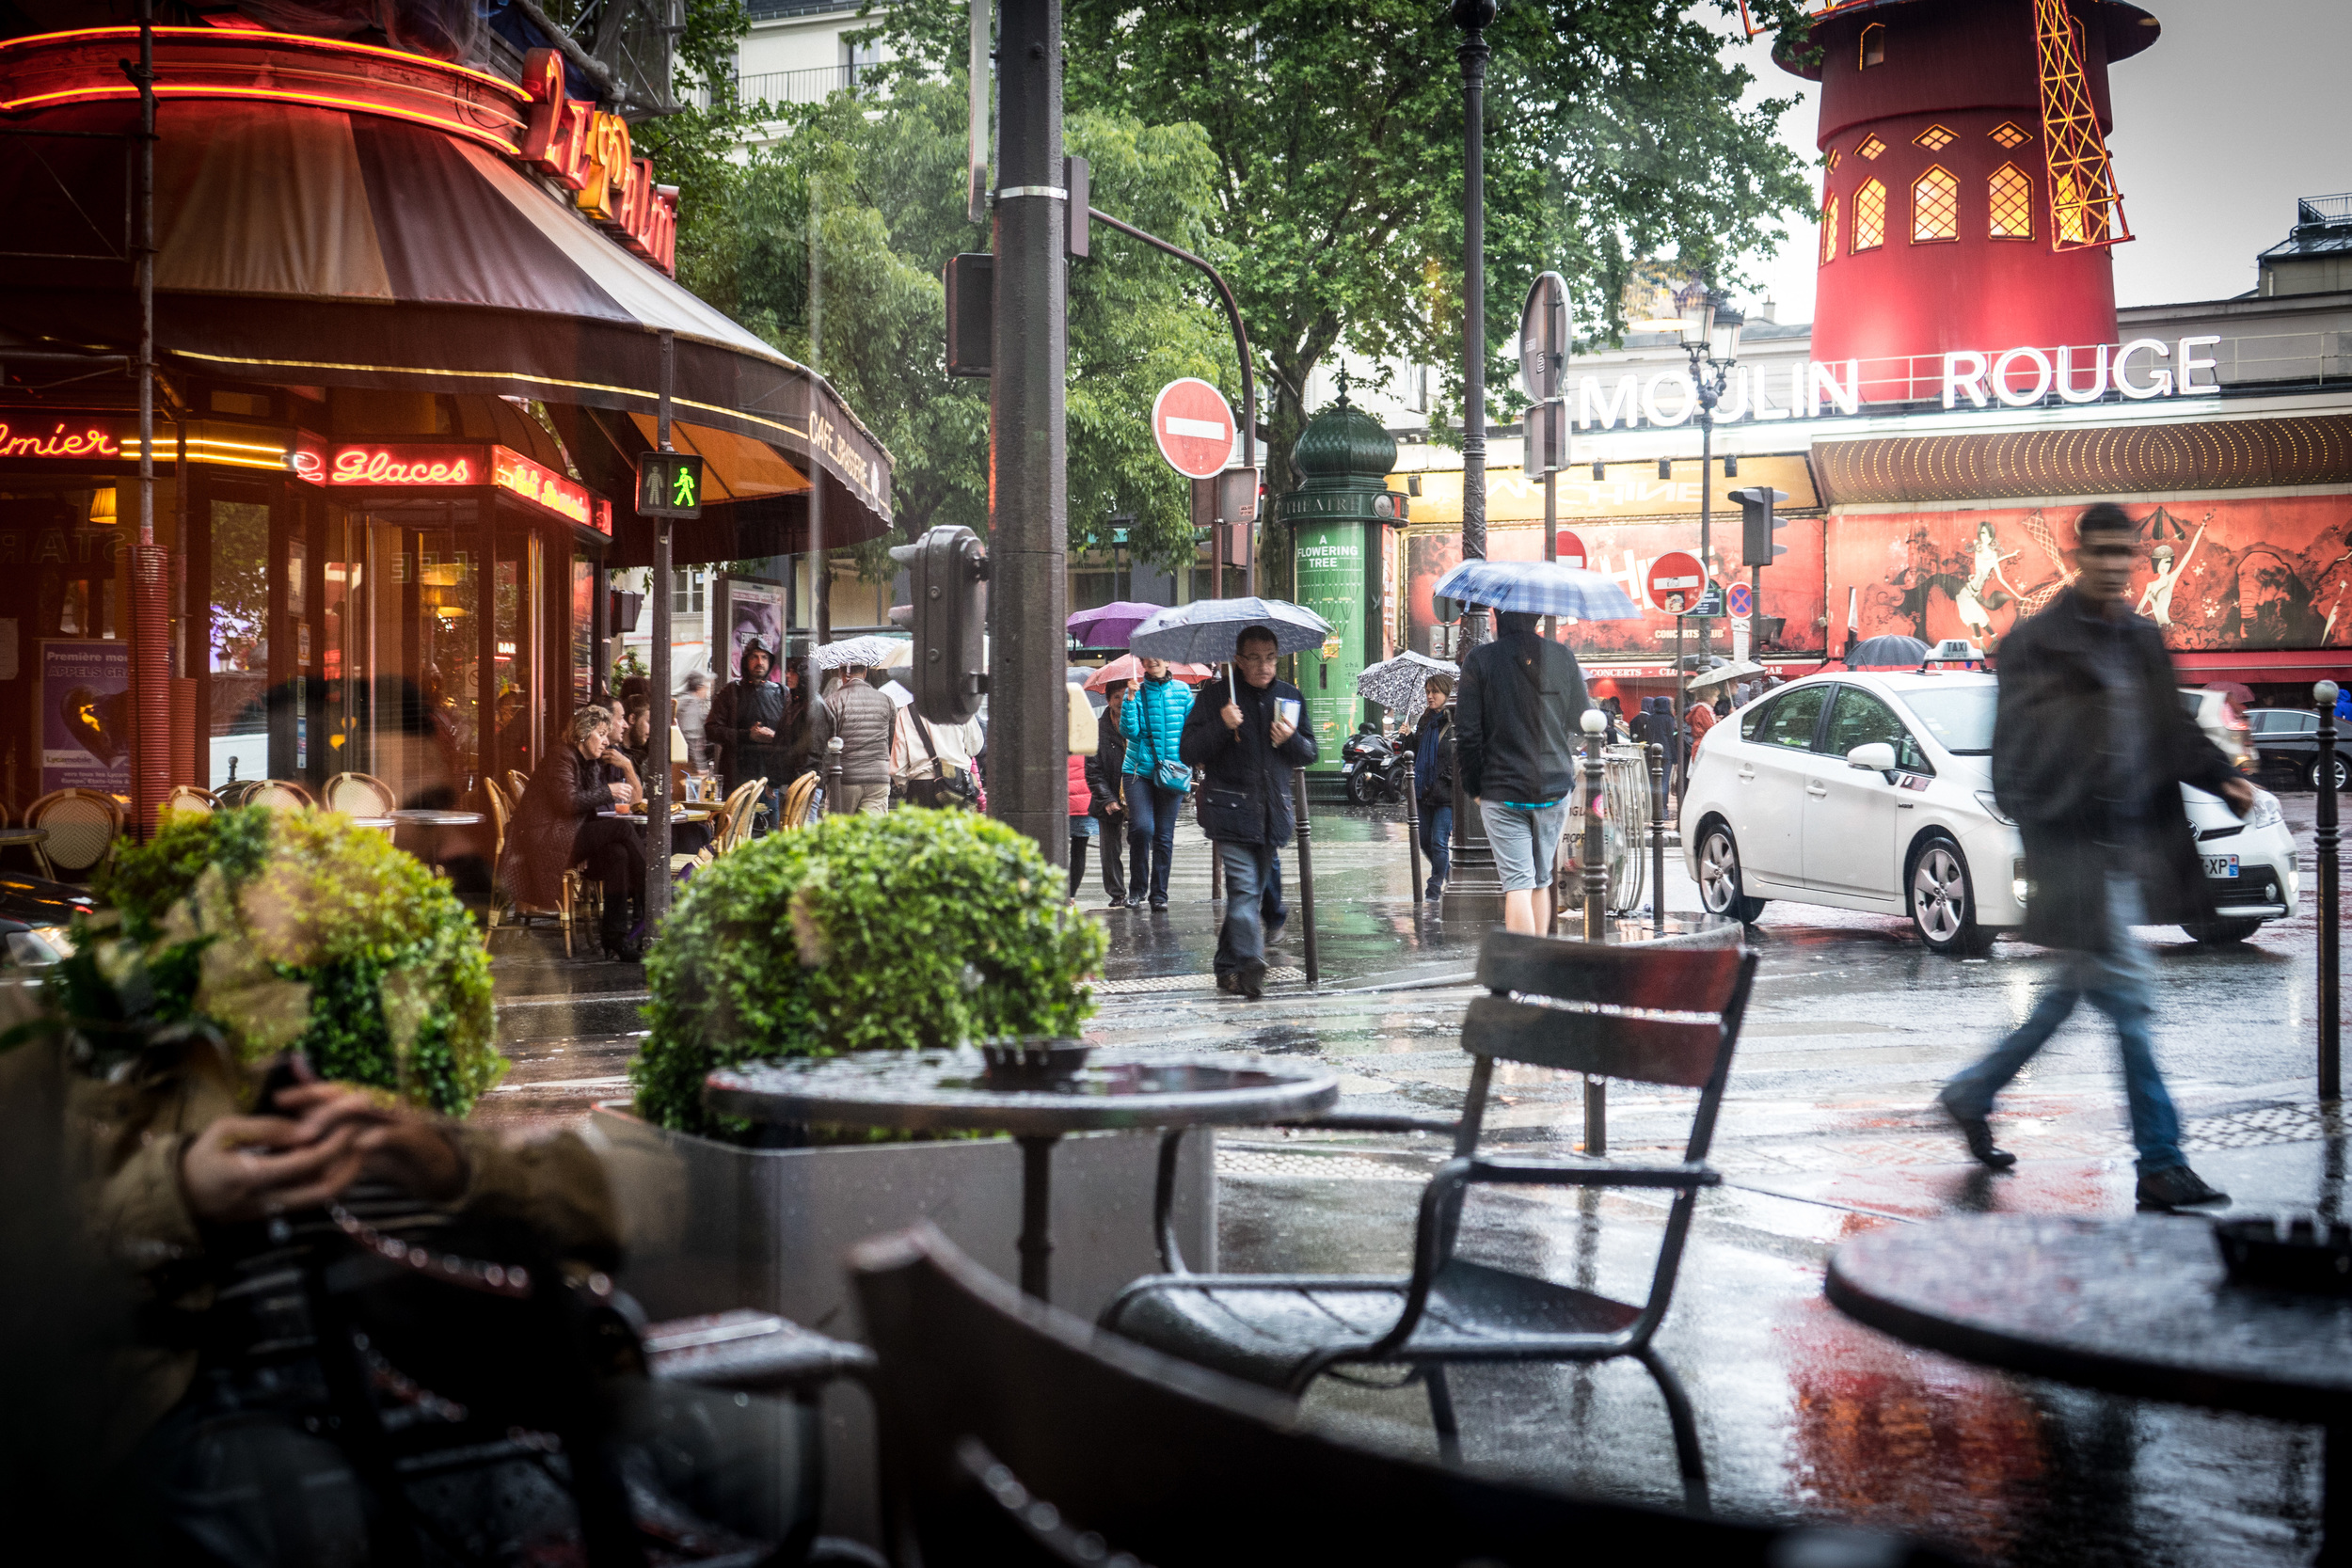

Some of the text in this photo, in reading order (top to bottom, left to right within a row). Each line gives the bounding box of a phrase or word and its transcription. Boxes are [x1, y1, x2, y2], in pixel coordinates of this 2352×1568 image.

[1579, 335, 2222, 431] MOULIN ROUGE
[332, 450, 469, 483] Glaces
[1319, 534, 1327, 545] A
[1297, 546, 1359, 558] FLOWERING
[1309, 558, 1338, 568] TREE
[1655, 629, 1700, 639] CONCRTS
[498, 641, 516, 655] BAR
[1947, 641, 1968, 652] TAXI
[47, 651, 102, 662] Première
[48, 666, 101, 678] APPELS
[1590, 667, 1642, 677] CONCERTS
[1659, 667, 1685, 677] CLU
